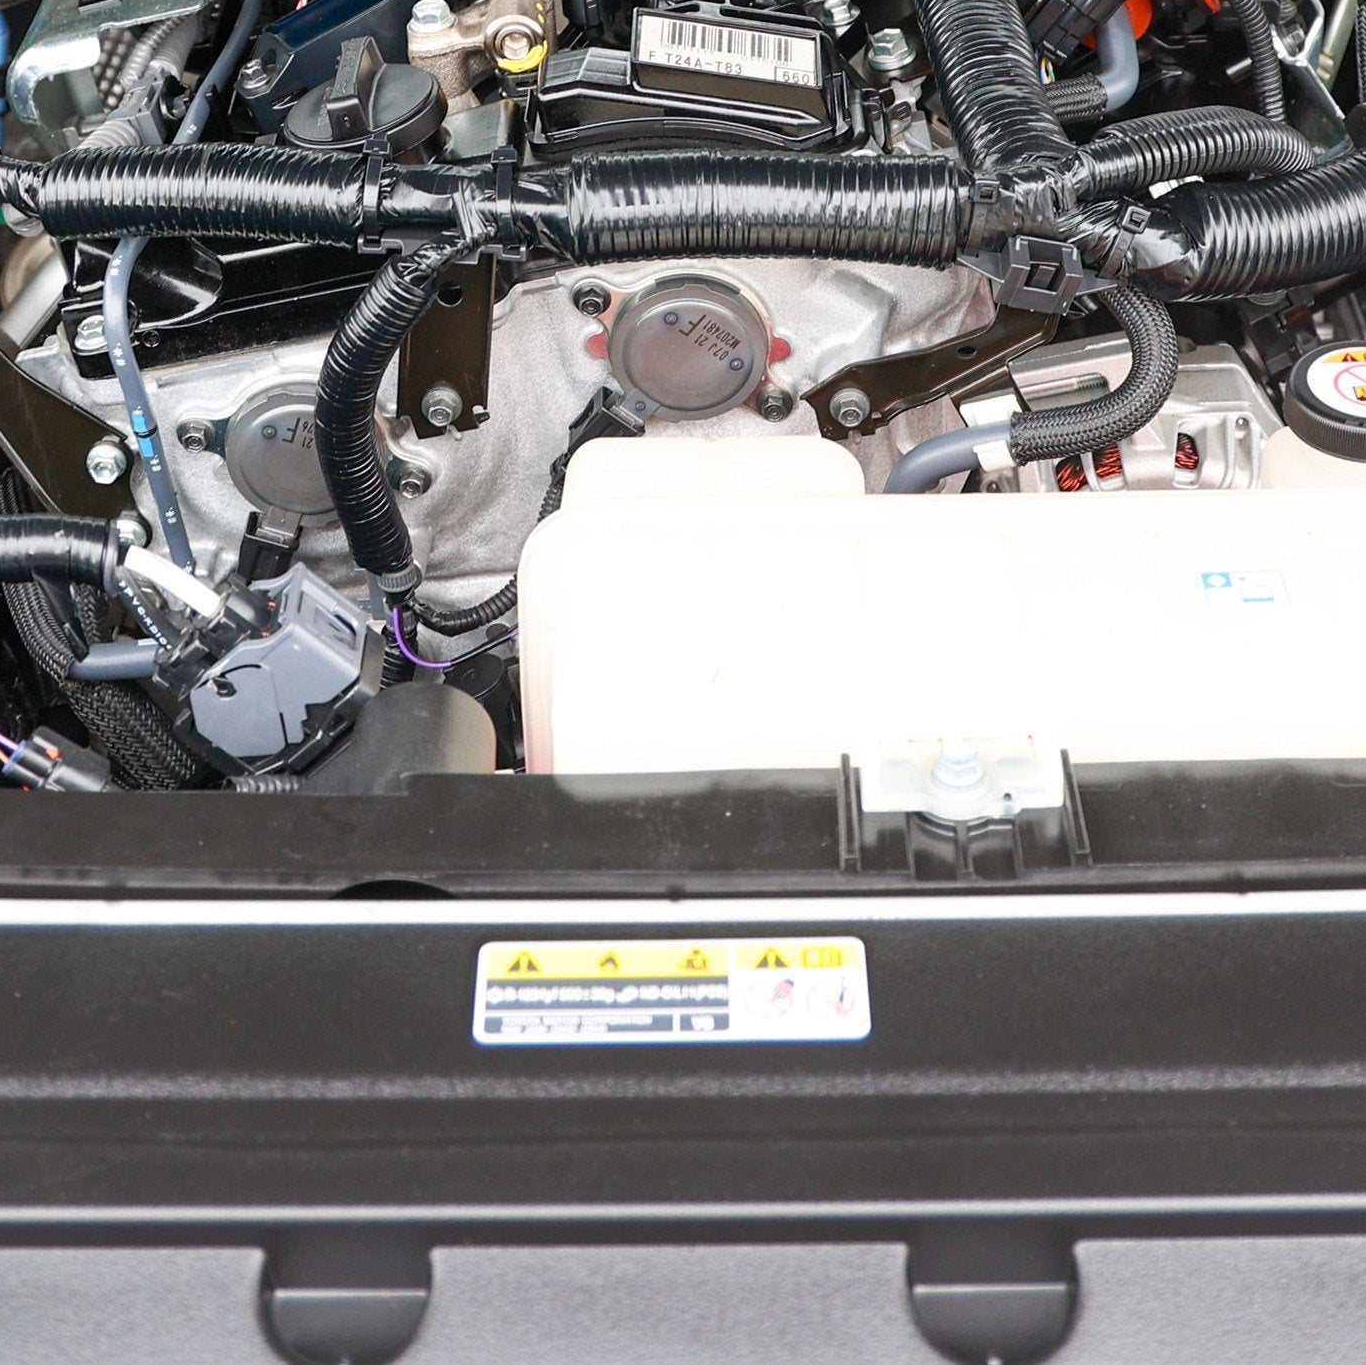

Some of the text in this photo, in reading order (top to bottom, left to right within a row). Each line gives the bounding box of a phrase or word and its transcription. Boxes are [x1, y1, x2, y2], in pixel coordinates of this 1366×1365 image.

[648, 50, 657, 61] F
[665, 53, 742, 75] T24A-T83
[782, 70, 810, 84] 660
